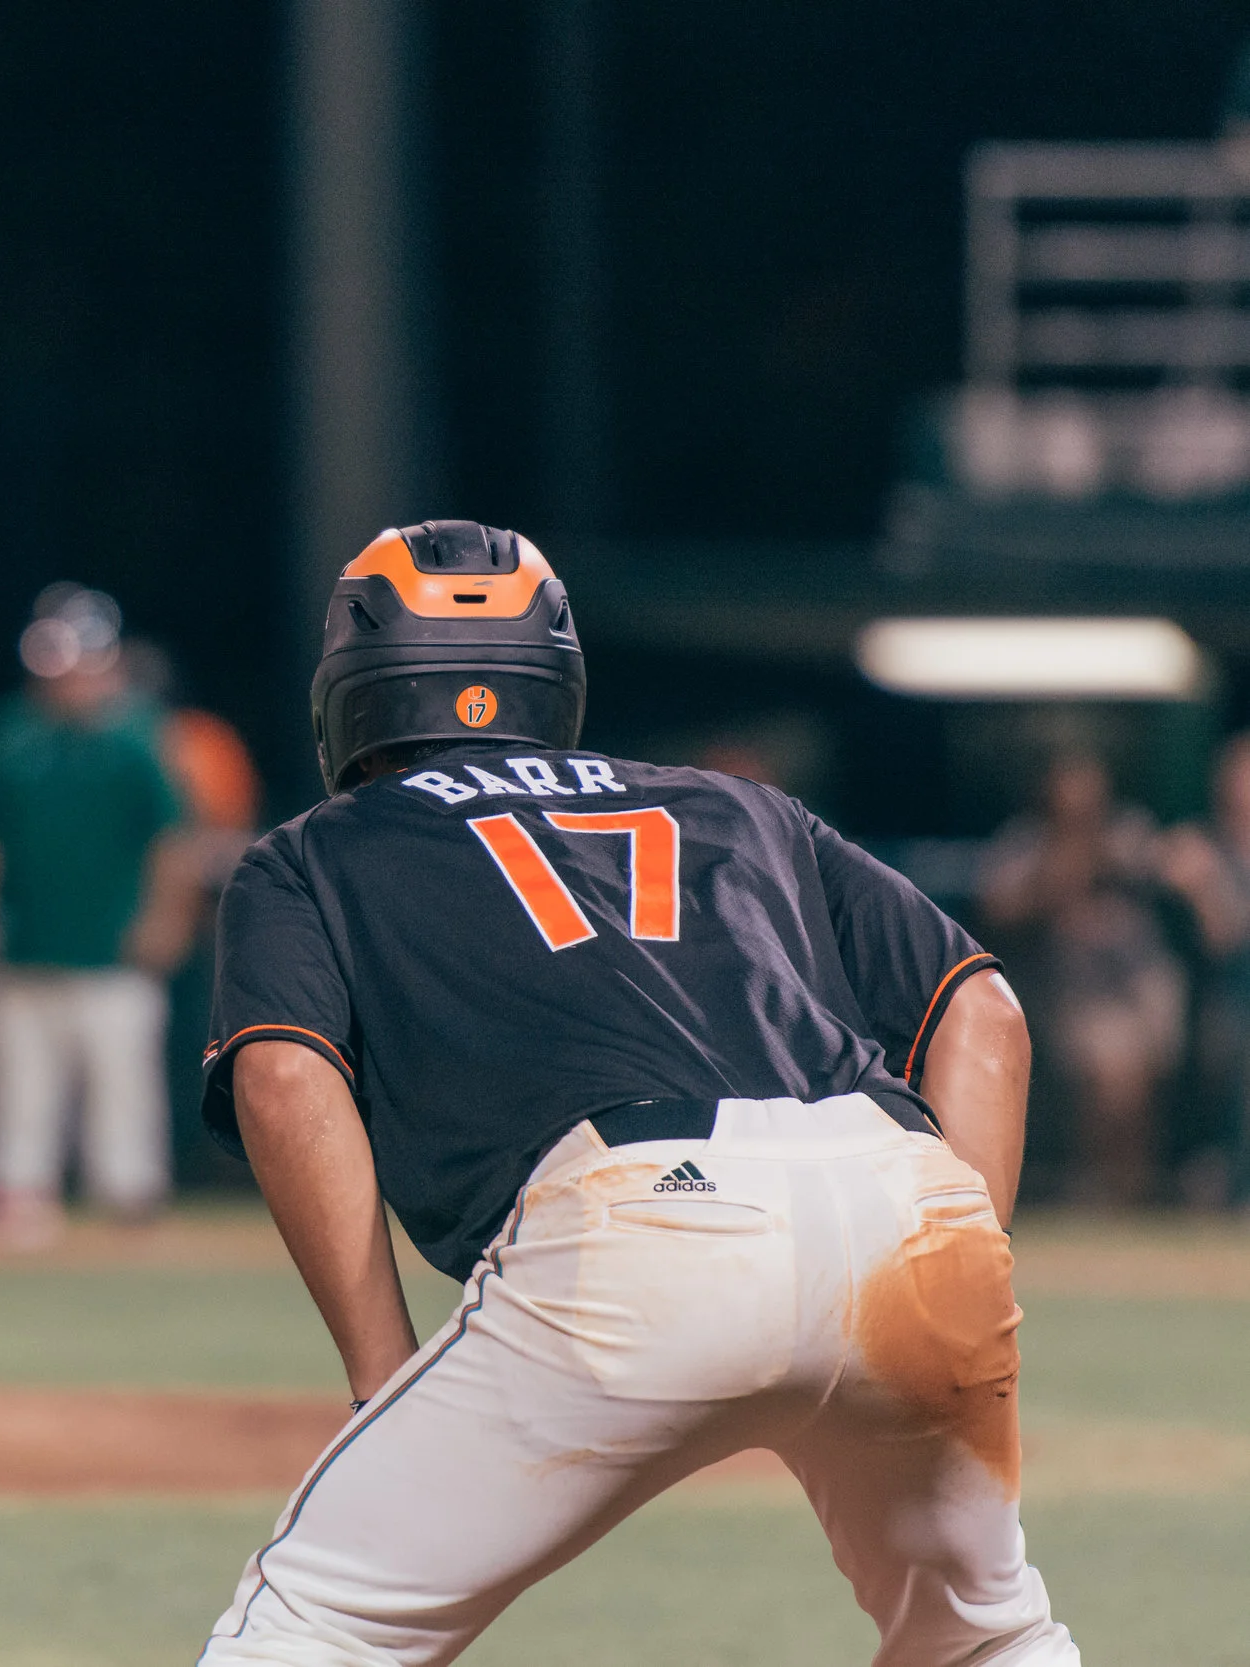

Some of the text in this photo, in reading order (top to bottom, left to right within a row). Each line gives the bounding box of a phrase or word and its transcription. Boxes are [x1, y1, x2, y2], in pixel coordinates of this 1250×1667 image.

[467, 702, 487, 724] 17
[401, 757, 627, 805] BARR
[466, 807, 680, 952] 17
[653, 1180, 717, 1193] adidas
